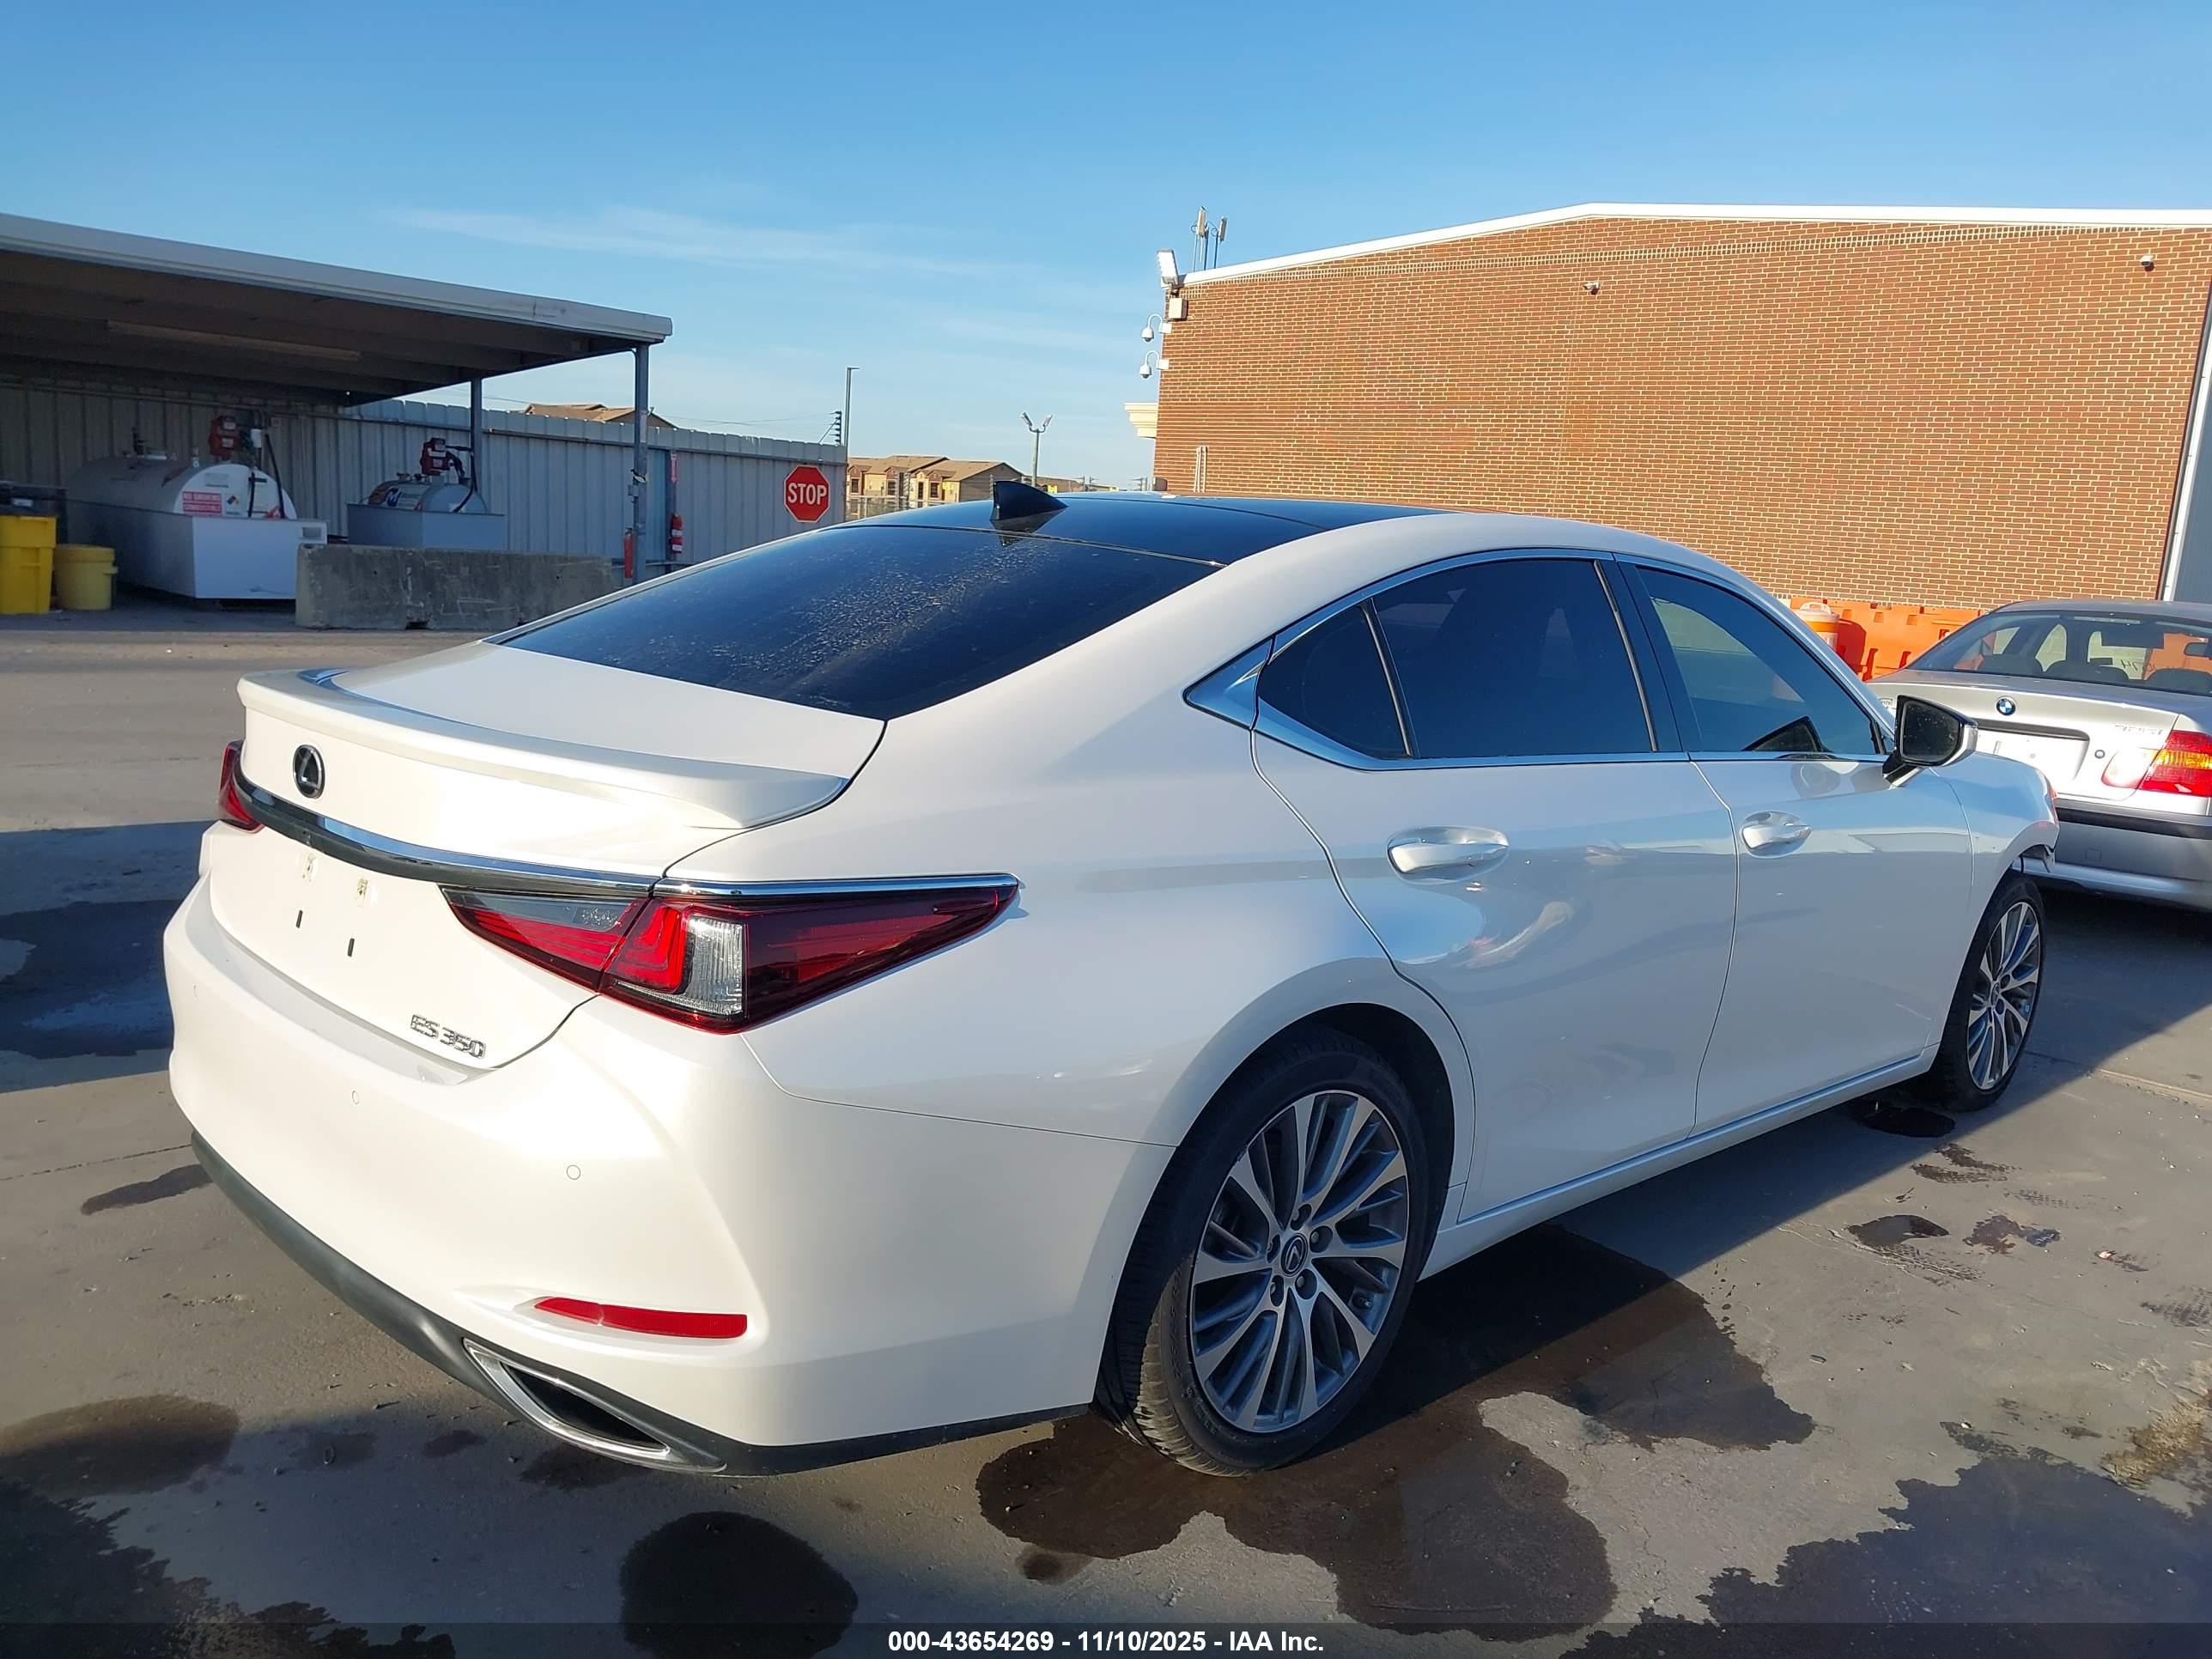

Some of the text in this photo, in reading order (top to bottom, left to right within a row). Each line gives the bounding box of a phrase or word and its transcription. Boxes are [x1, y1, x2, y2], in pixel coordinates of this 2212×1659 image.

[787, 483, 827, 505] STOP
[410, 1014, 487, 1059] ES 350
